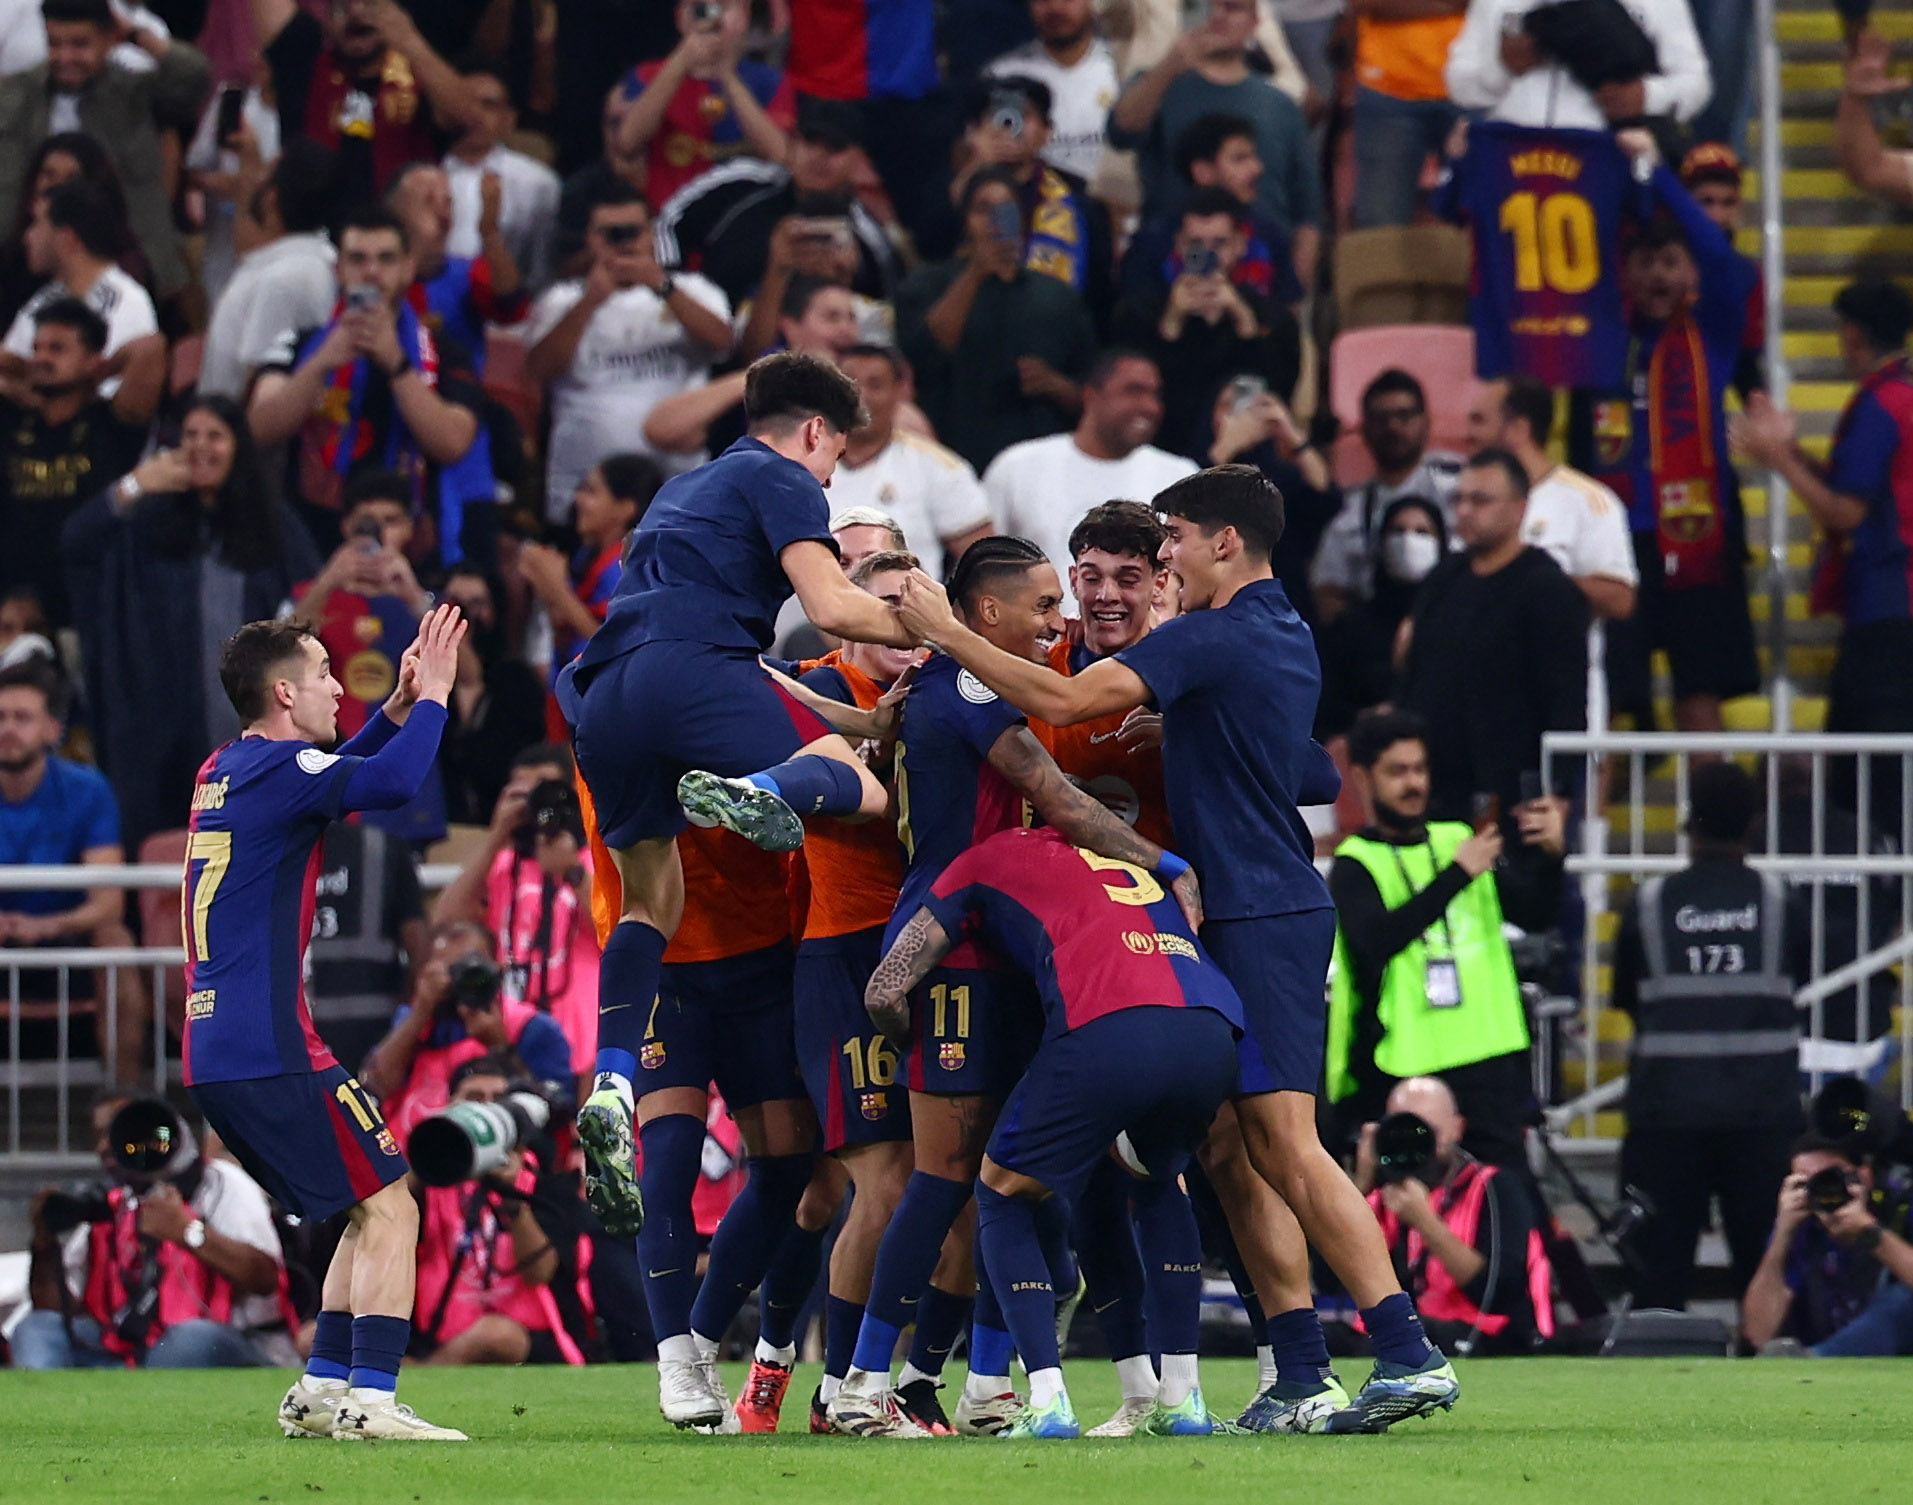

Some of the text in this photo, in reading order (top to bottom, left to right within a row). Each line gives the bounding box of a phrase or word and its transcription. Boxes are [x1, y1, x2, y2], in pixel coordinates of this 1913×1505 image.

[1499, 191, 1601, 293] 10
[1078, 847, 1165, 906] 5
[1675, 904, 1758, 933] Guard
[1685, 944, 1745, 974] 173
[929, 983, 970, 1039] 11
[842, 1034, 898, 1089] 16
